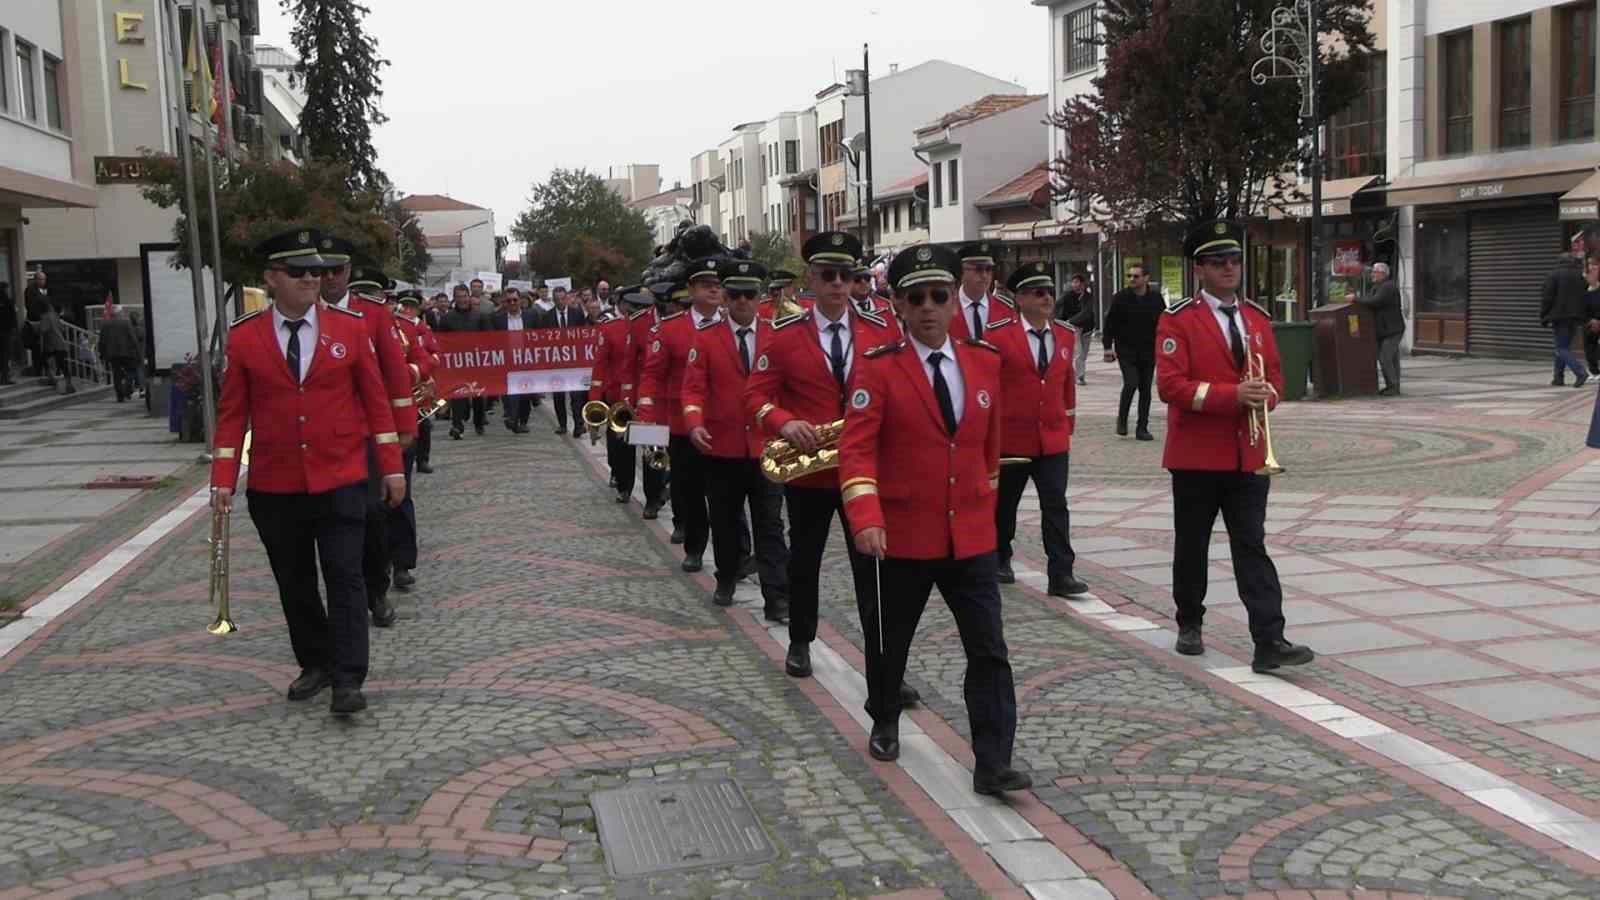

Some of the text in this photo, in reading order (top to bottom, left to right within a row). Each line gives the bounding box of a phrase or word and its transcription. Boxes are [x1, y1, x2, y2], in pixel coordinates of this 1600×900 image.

[114, 0, 149, 93] EL
[527, 330, 561, 341] 15-22
[443, 343, 598, 369] TURİZM HAFTASI K
